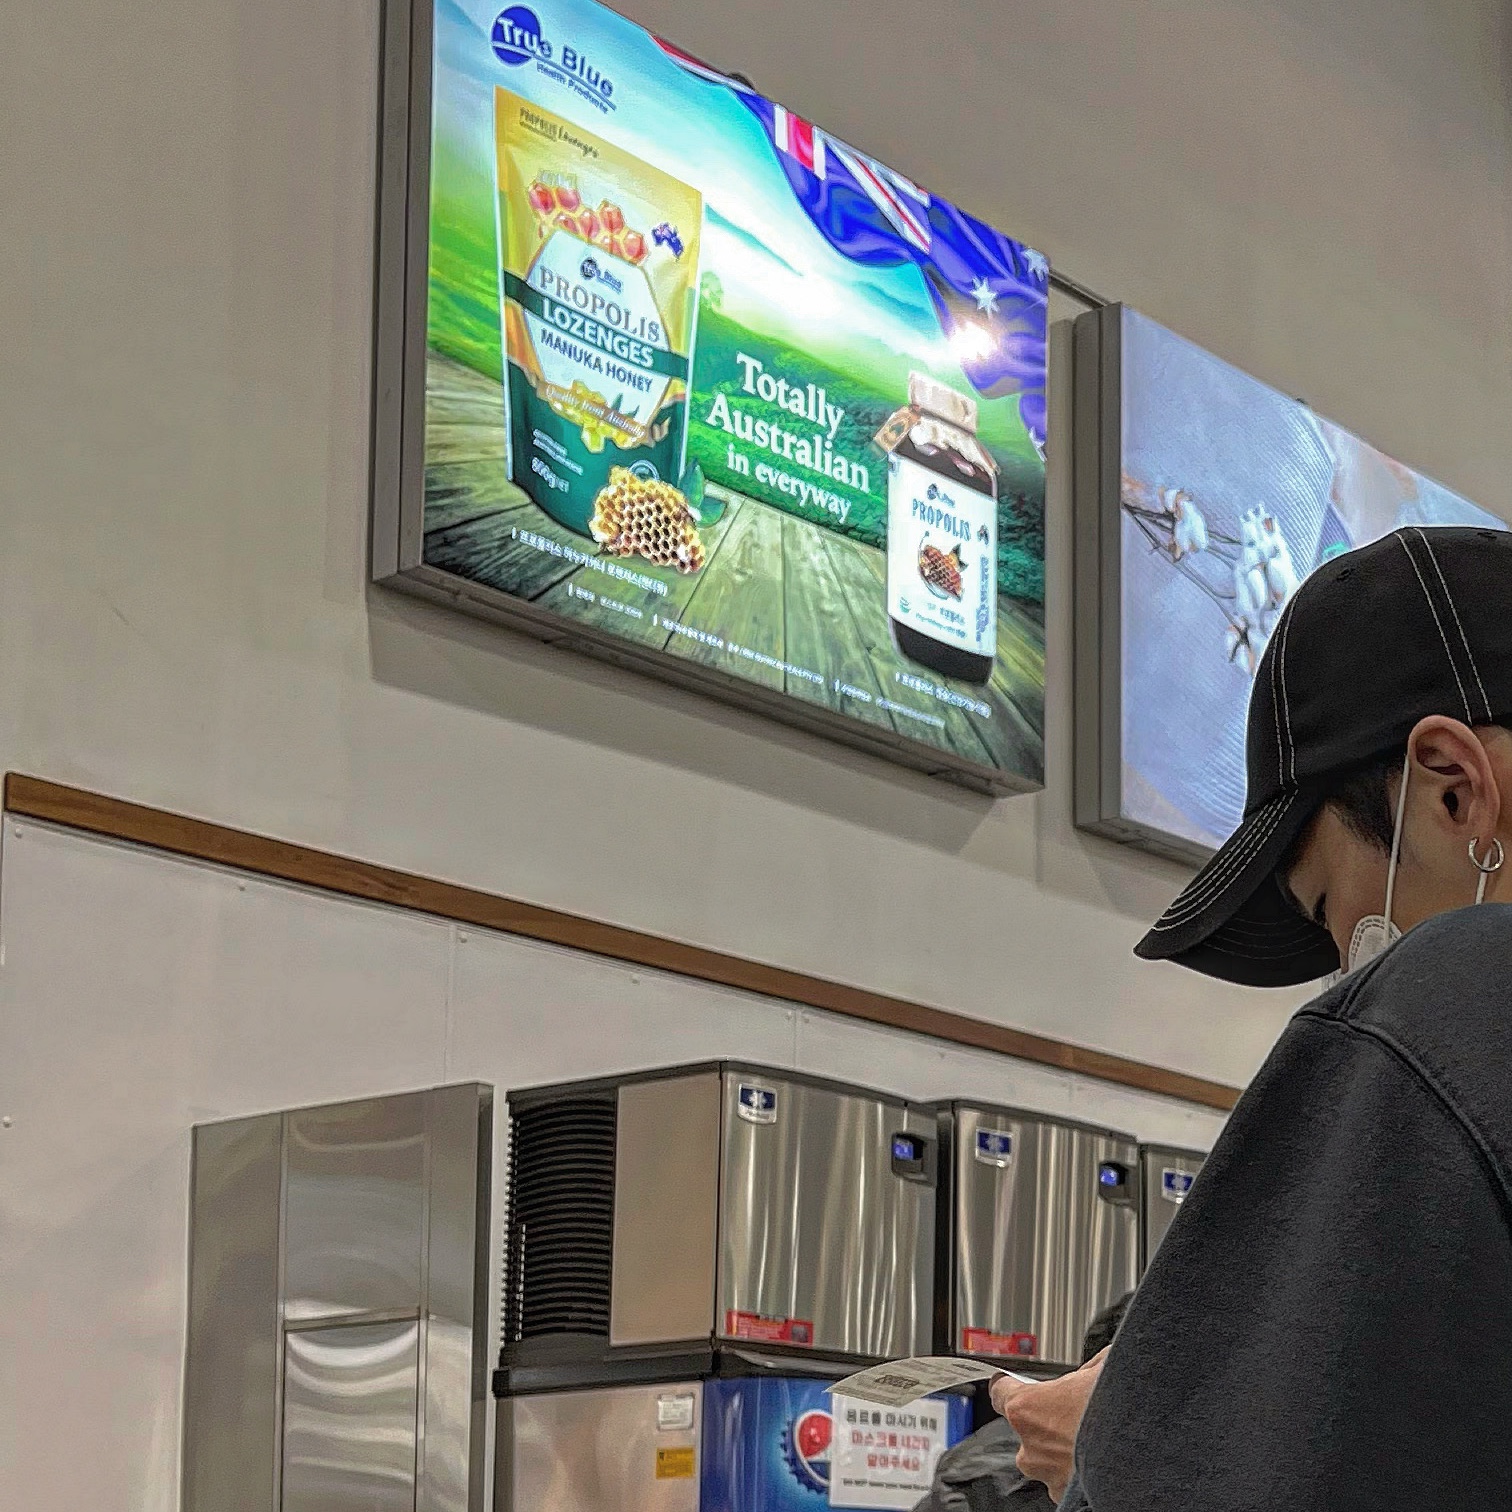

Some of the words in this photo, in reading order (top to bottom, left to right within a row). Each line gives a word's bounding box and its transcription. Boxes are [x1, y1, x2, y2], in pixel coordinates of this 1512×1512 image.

[497, 17, 552, 58] True
[561, 44, 613, 98] Blue
[540, 266, 660, 342] PROPOLIS
[542, 297, 654, 368] LOZENGES
[541, 328, 603, 374] MANUKA
[606, 361, 653, 393] HONEY
[736, 351, 845, 440] Totally
[706, 392, 870, 494] Australian
[727, 443, 750, 476] in
[754, 462, 851, 524] everyway
[912, 498, 972, 542] PROPOLIS
[885, 1412, 917, 1429] 마시기
